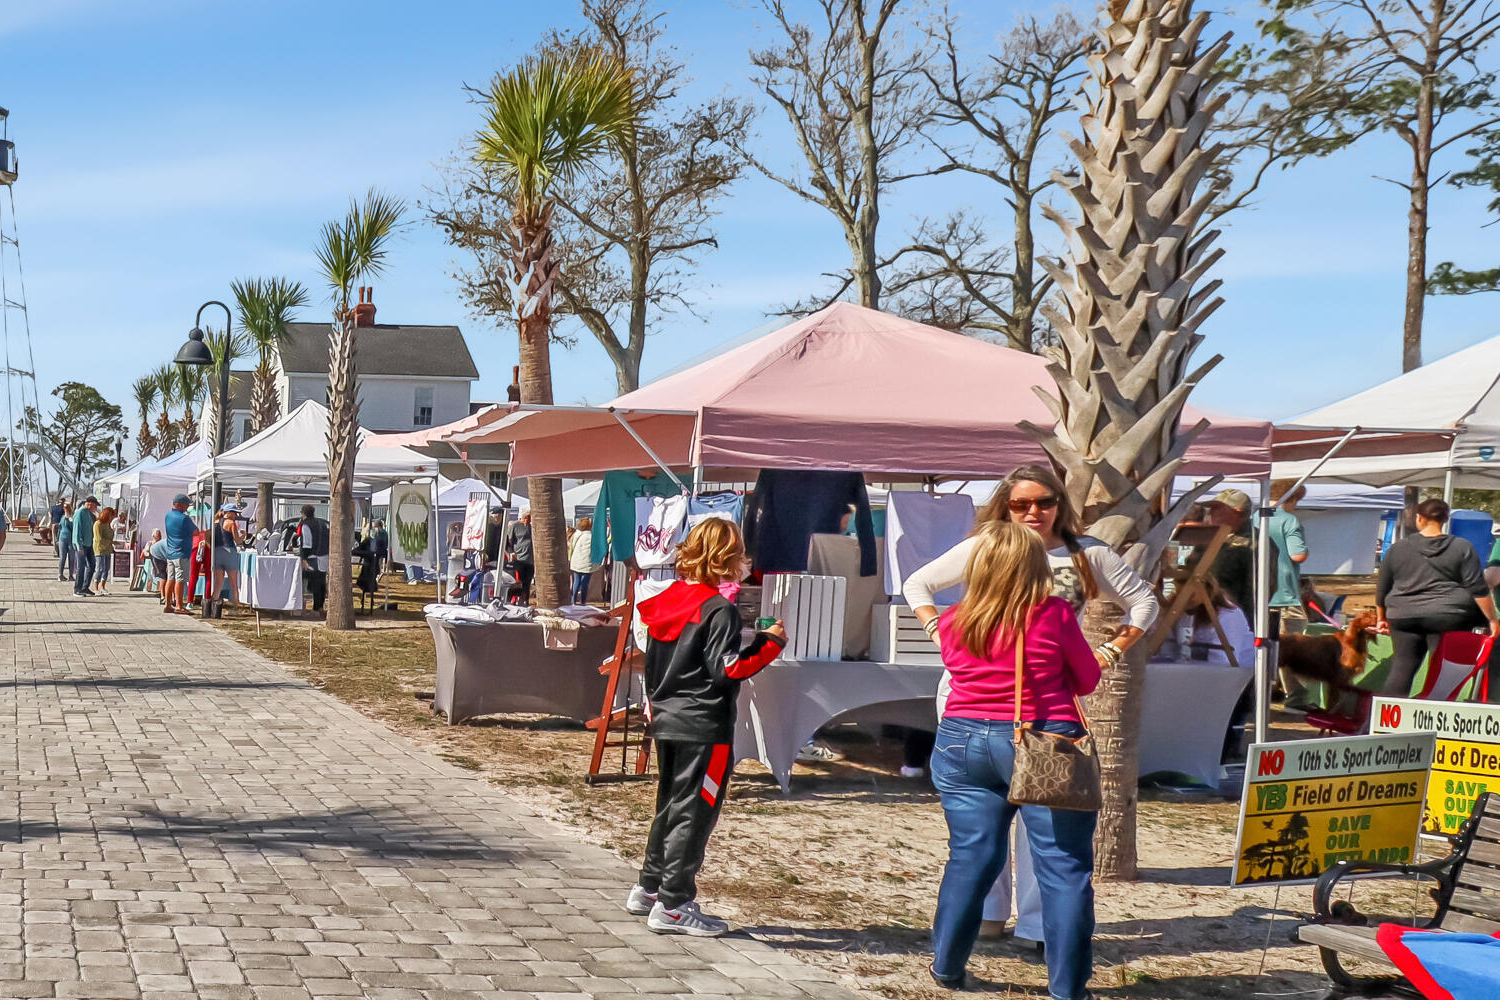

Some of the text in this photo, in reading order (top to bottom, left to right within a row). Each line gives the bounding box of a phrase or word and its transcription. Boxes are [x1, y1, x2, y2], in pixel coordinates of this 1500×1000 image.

[1380, 704, 1500, 738] NO 10th St. Sport Co
[1258, 743, 1423, 776] NO 10th St. Sport Complex
[1450, 746, 1466, 768] of
[1470, 748, 1500, 771] Dre
[1256, 780, 1418, 811] YES Field of Dreams
[1445, 779, 1487, 796] SAVE
[1328, 814, 1371, 833] SAVE
[1326, 833, 1360, 850] OUR
